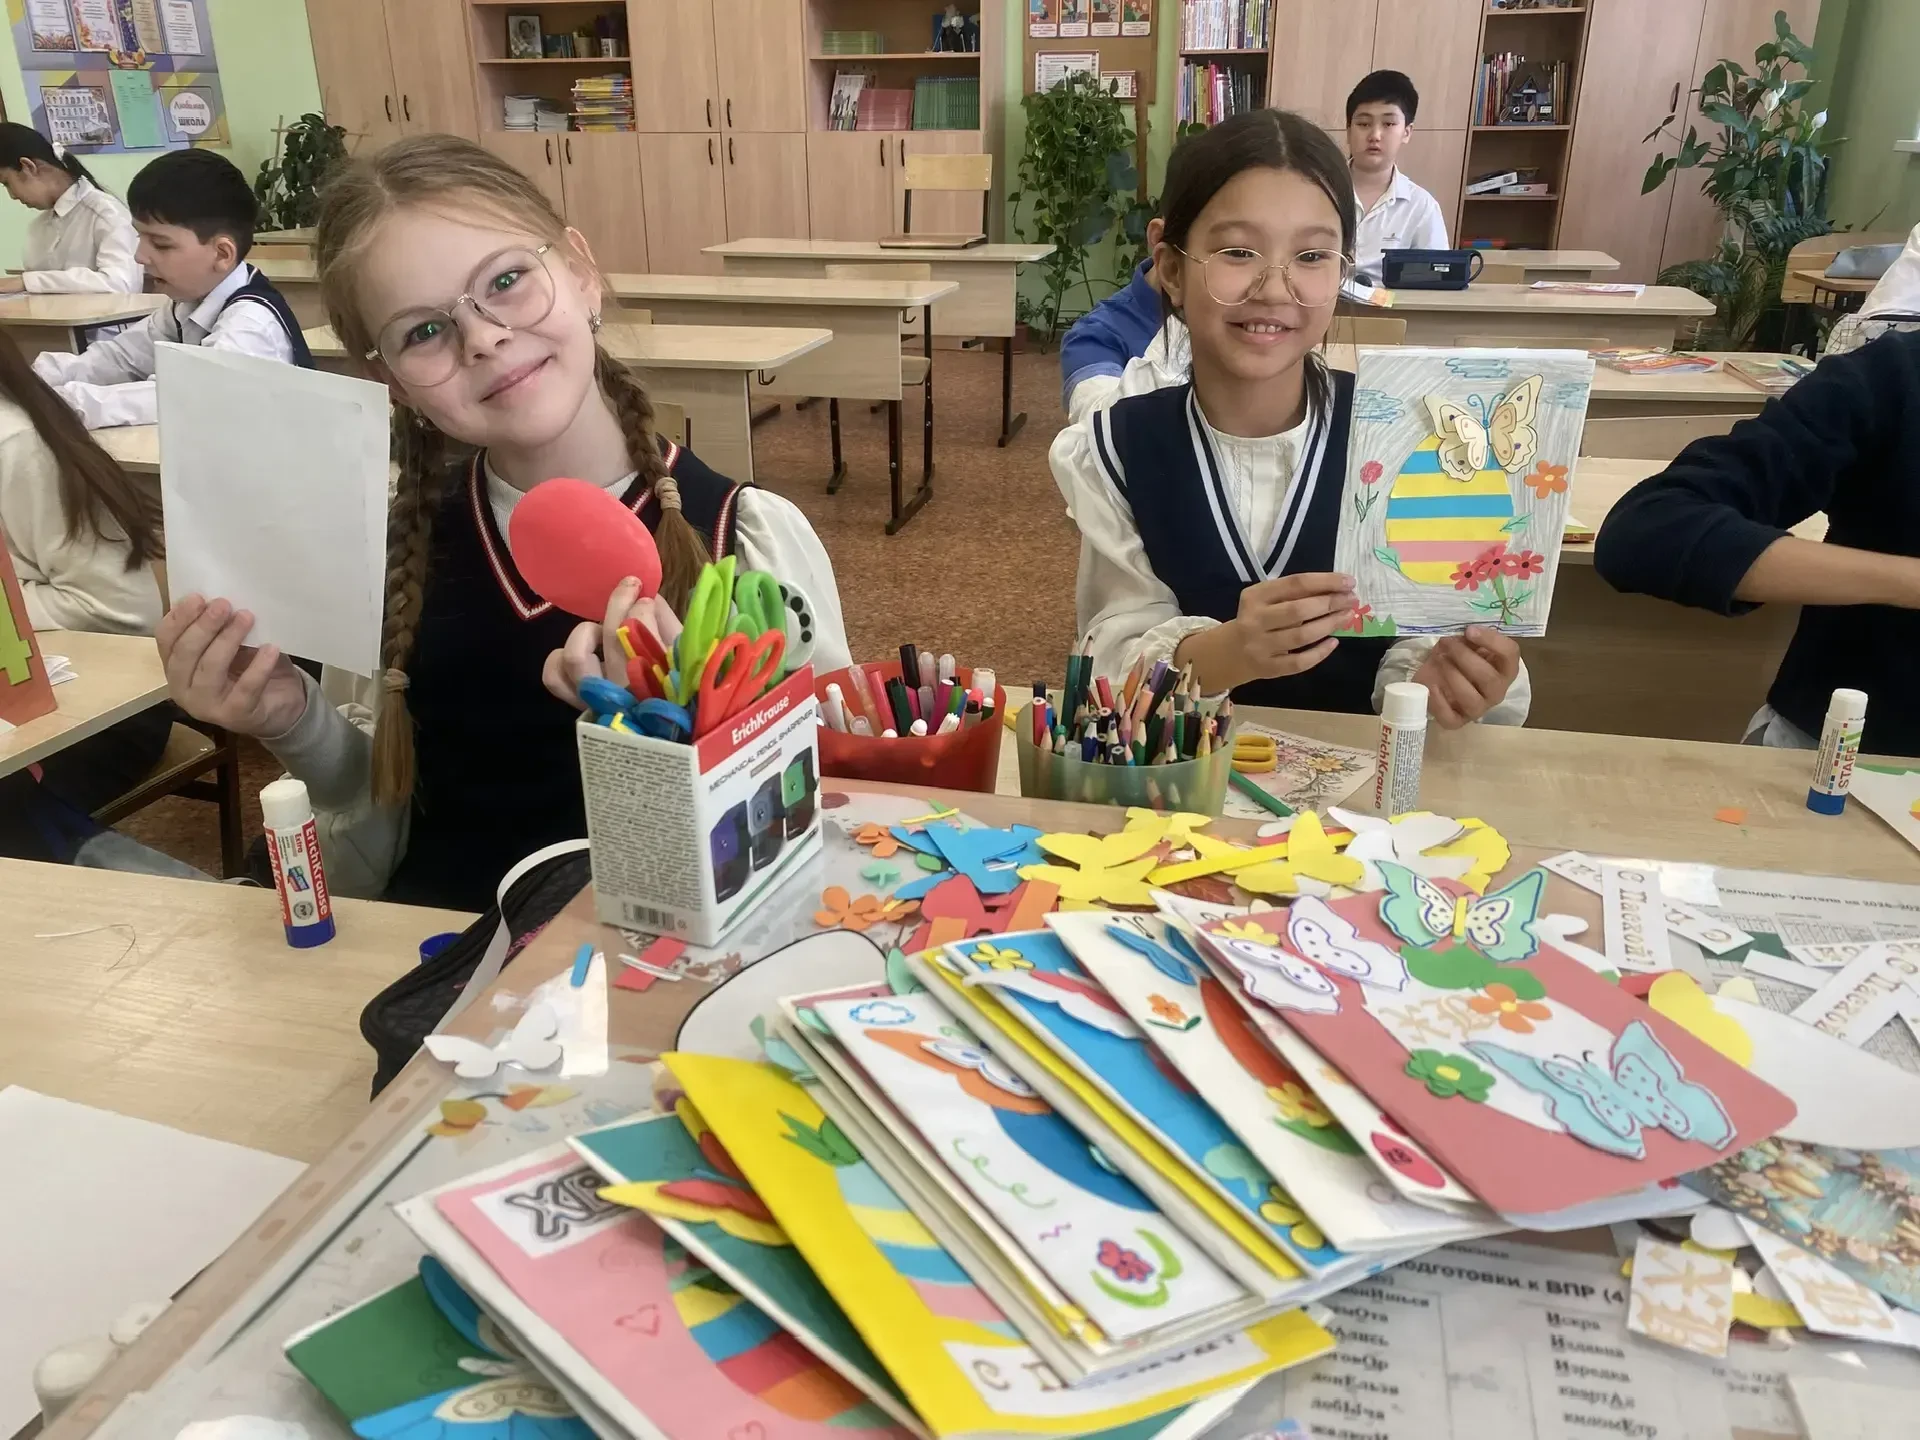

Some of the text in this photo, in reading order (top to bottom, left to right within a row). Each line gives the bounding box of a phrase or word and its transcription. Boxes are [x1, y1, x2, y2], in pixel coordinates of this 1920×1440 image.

[731, 695, 790, 746] ErichKrause
[1375, 724, 1393, 810] ErichKrause
[305, 825, 328, 916] ErichKrause
[1546, 1279, 1597, 1298] ВПР
